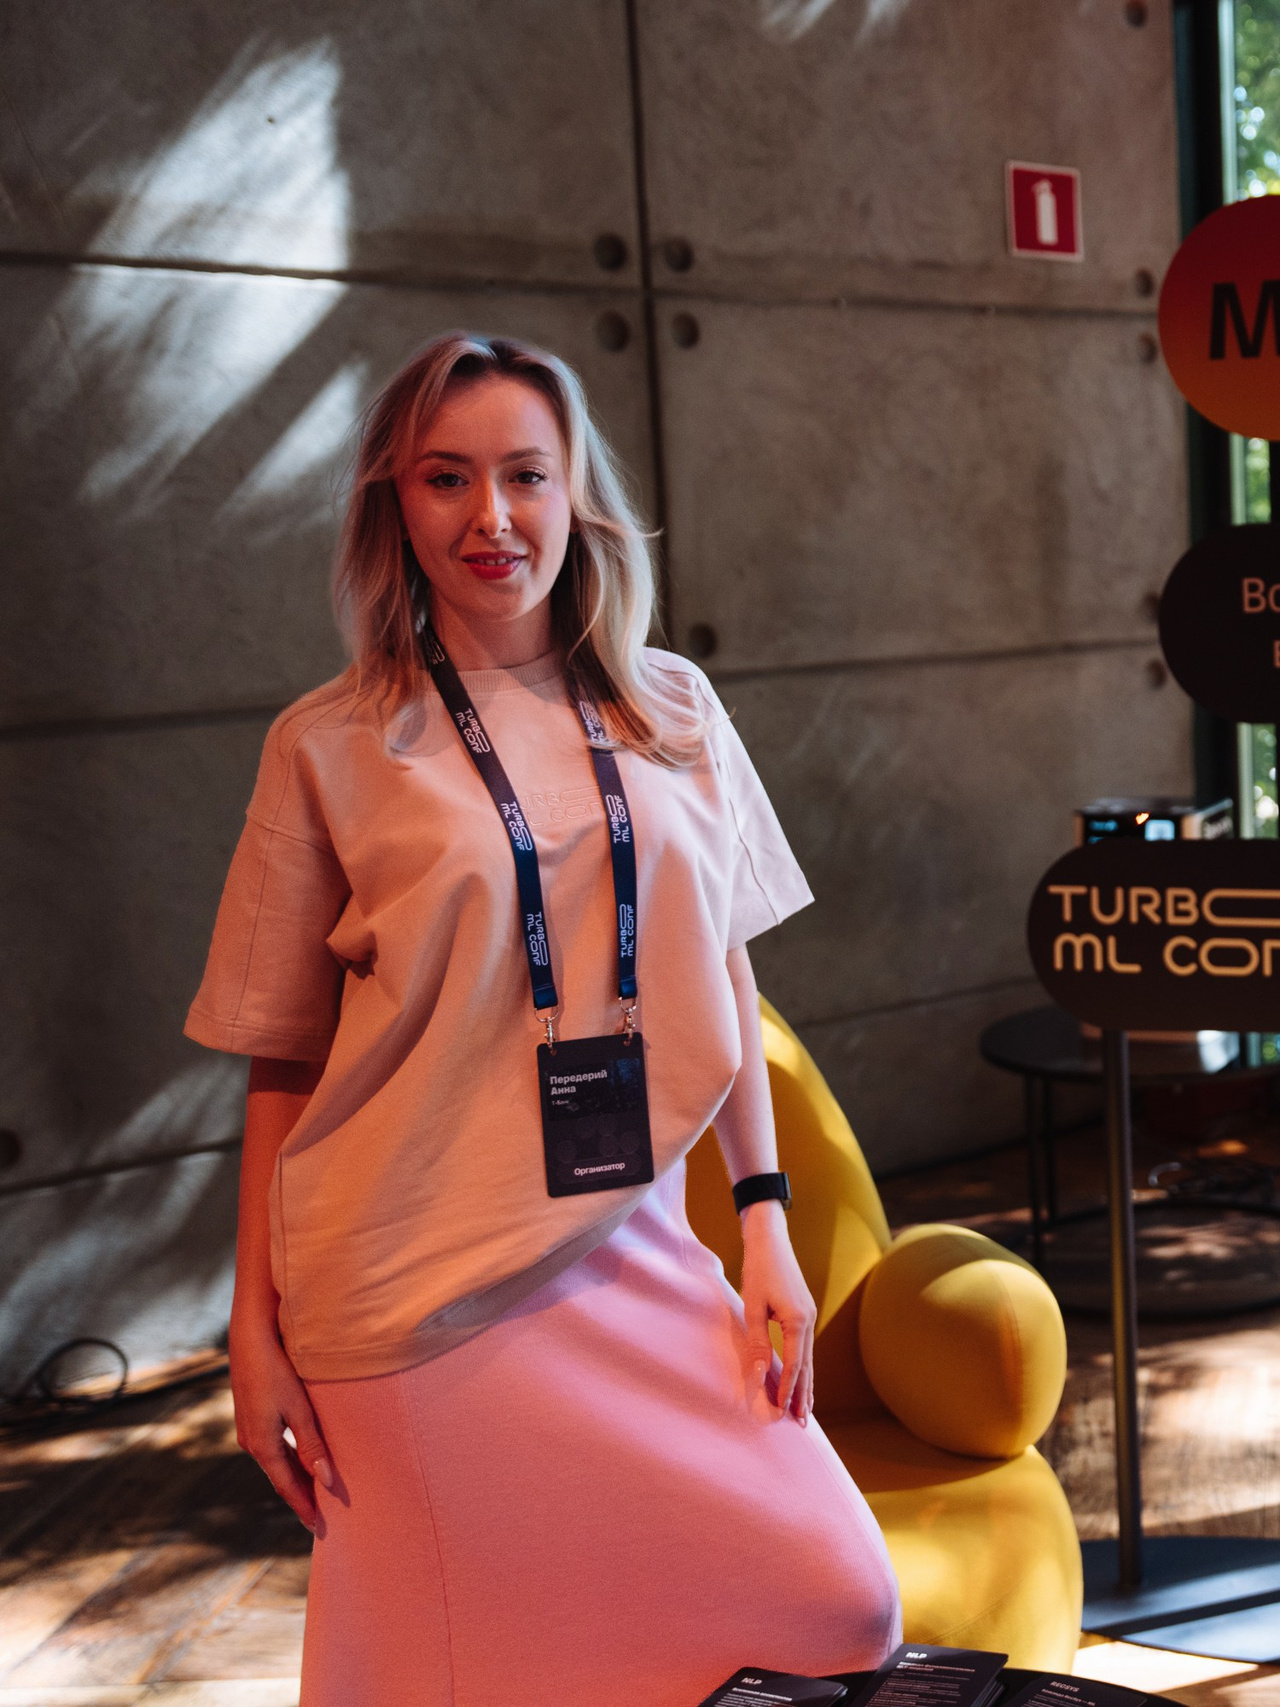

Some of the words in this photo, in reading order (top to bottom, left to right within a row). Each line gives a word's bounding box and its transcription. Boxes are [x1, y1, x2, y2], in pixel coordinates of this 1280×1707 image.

[455, 711, 465, 727] ML
[463, 727, 482, 754] CONF
[464, 707, 491, 753] TURBO
[605, 794, 621, 844] TURBO
[613, 794, 628, 824] CONF
[500, 802, 512, 819] ML
[508, 820, 526, 851] CONF
[509, 800, 533, 851] TURBO
[621, 825, 631, 843] ML
[526, 913, 534, 931] ML
[619, 903, 628, 958] TURBO
[627, 904, 635, 936] CONF
[528, 934, 541, 966] CONF
[534, 911, 549, 966] TURBO
[627, 939, 634, 957] ML
[1053, 932, 1142, 974] ML
[549, 1069, 608, 1085] Передерий
[550, 1084, 577, 1096] Анна
[573, 1162, 626, 1177] Организатор
[905, 1651, 928, 1660] NLP
[741, 1676, 763, 1686] NLP
